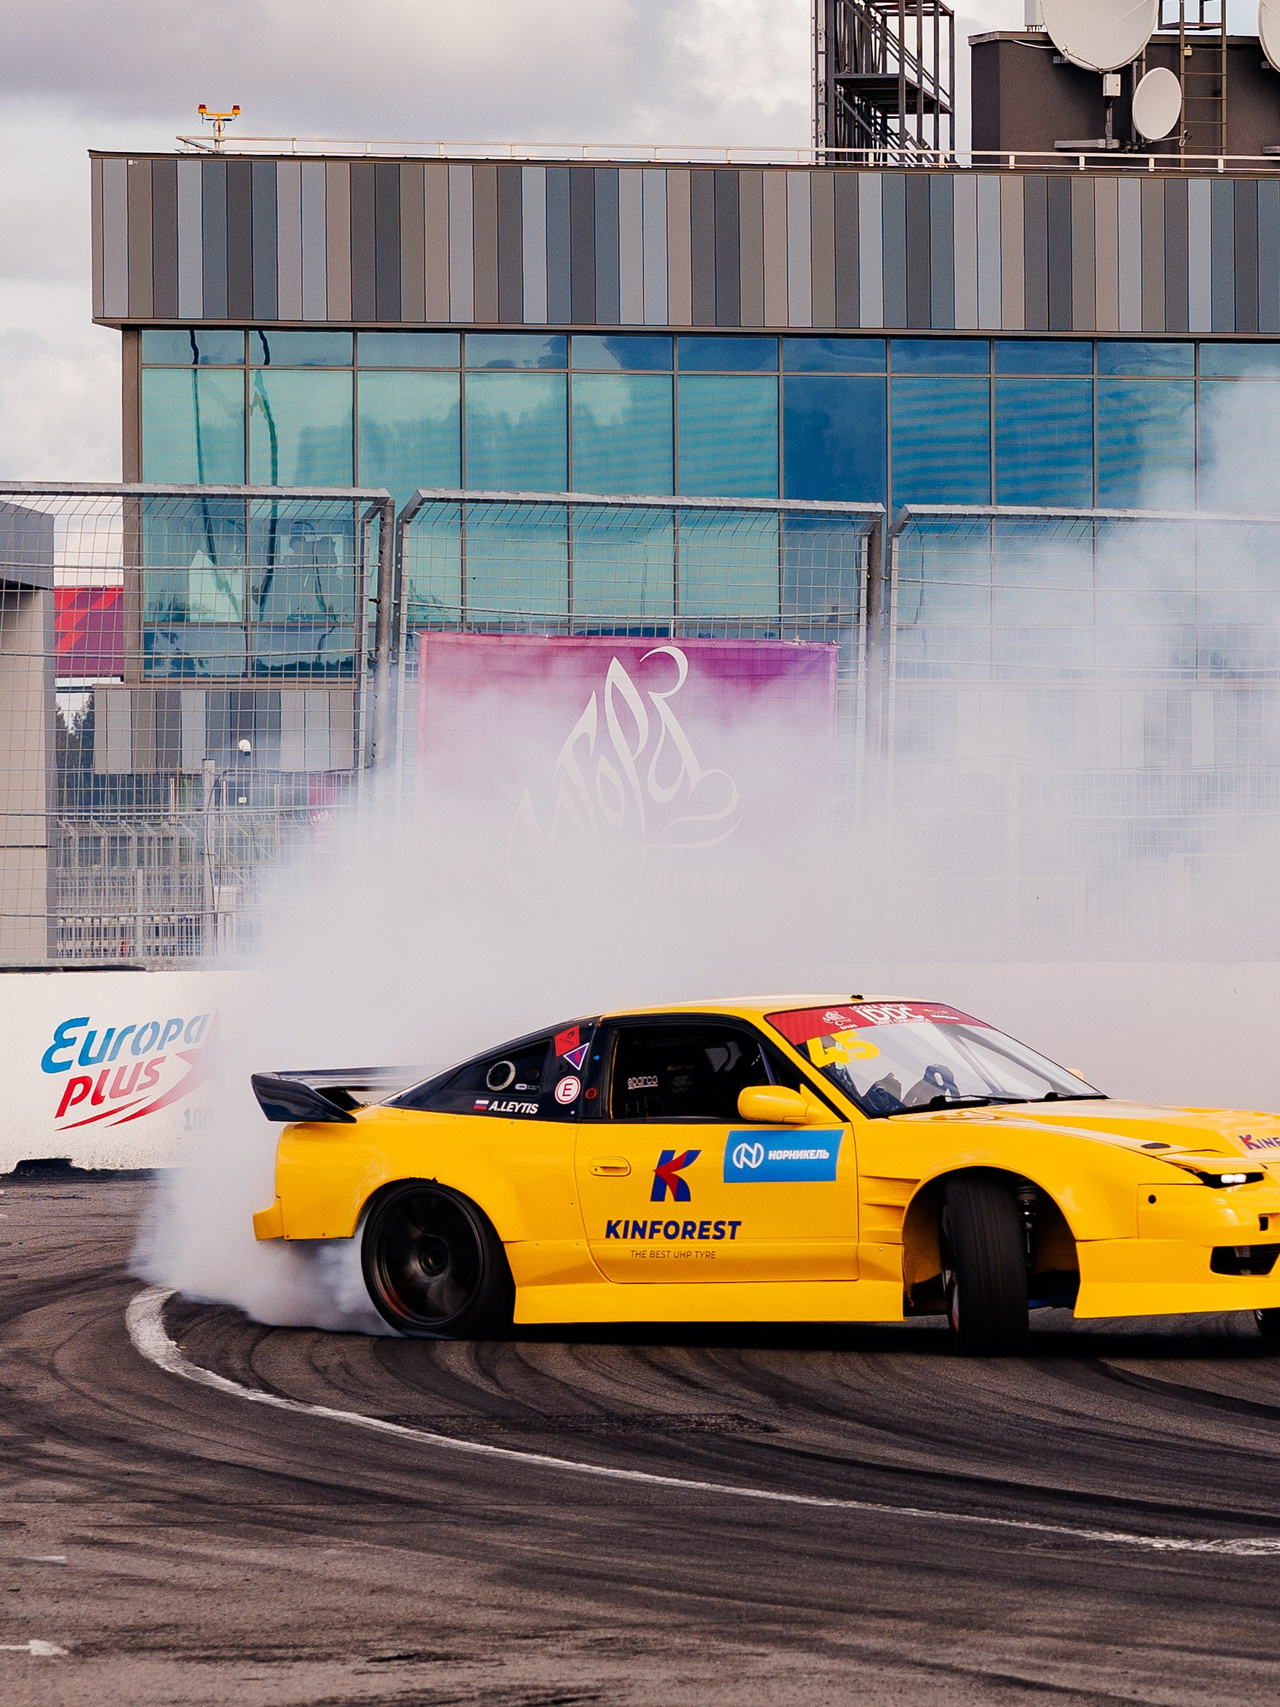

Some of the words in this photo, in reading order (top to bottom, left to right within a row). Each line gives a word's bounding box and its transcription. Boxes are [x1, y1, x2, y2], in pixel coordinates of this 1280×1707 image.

[855, 1007, 925, 1023] IDDC
[806, 1030, 880, 1068] 45
[562, 1083, 574, 1097] E
[768, 1149, 830, 1160] НОРНИКЕЛЬ
[605, 1220, 742, 1240] KINFOREST
[631, 1250, 647, 1259] THE
[650, 1250, 671, 1259] BEST
[674, 1250, 692, 1259] UHP
[695, 1251, 716, 1260] TYRE
